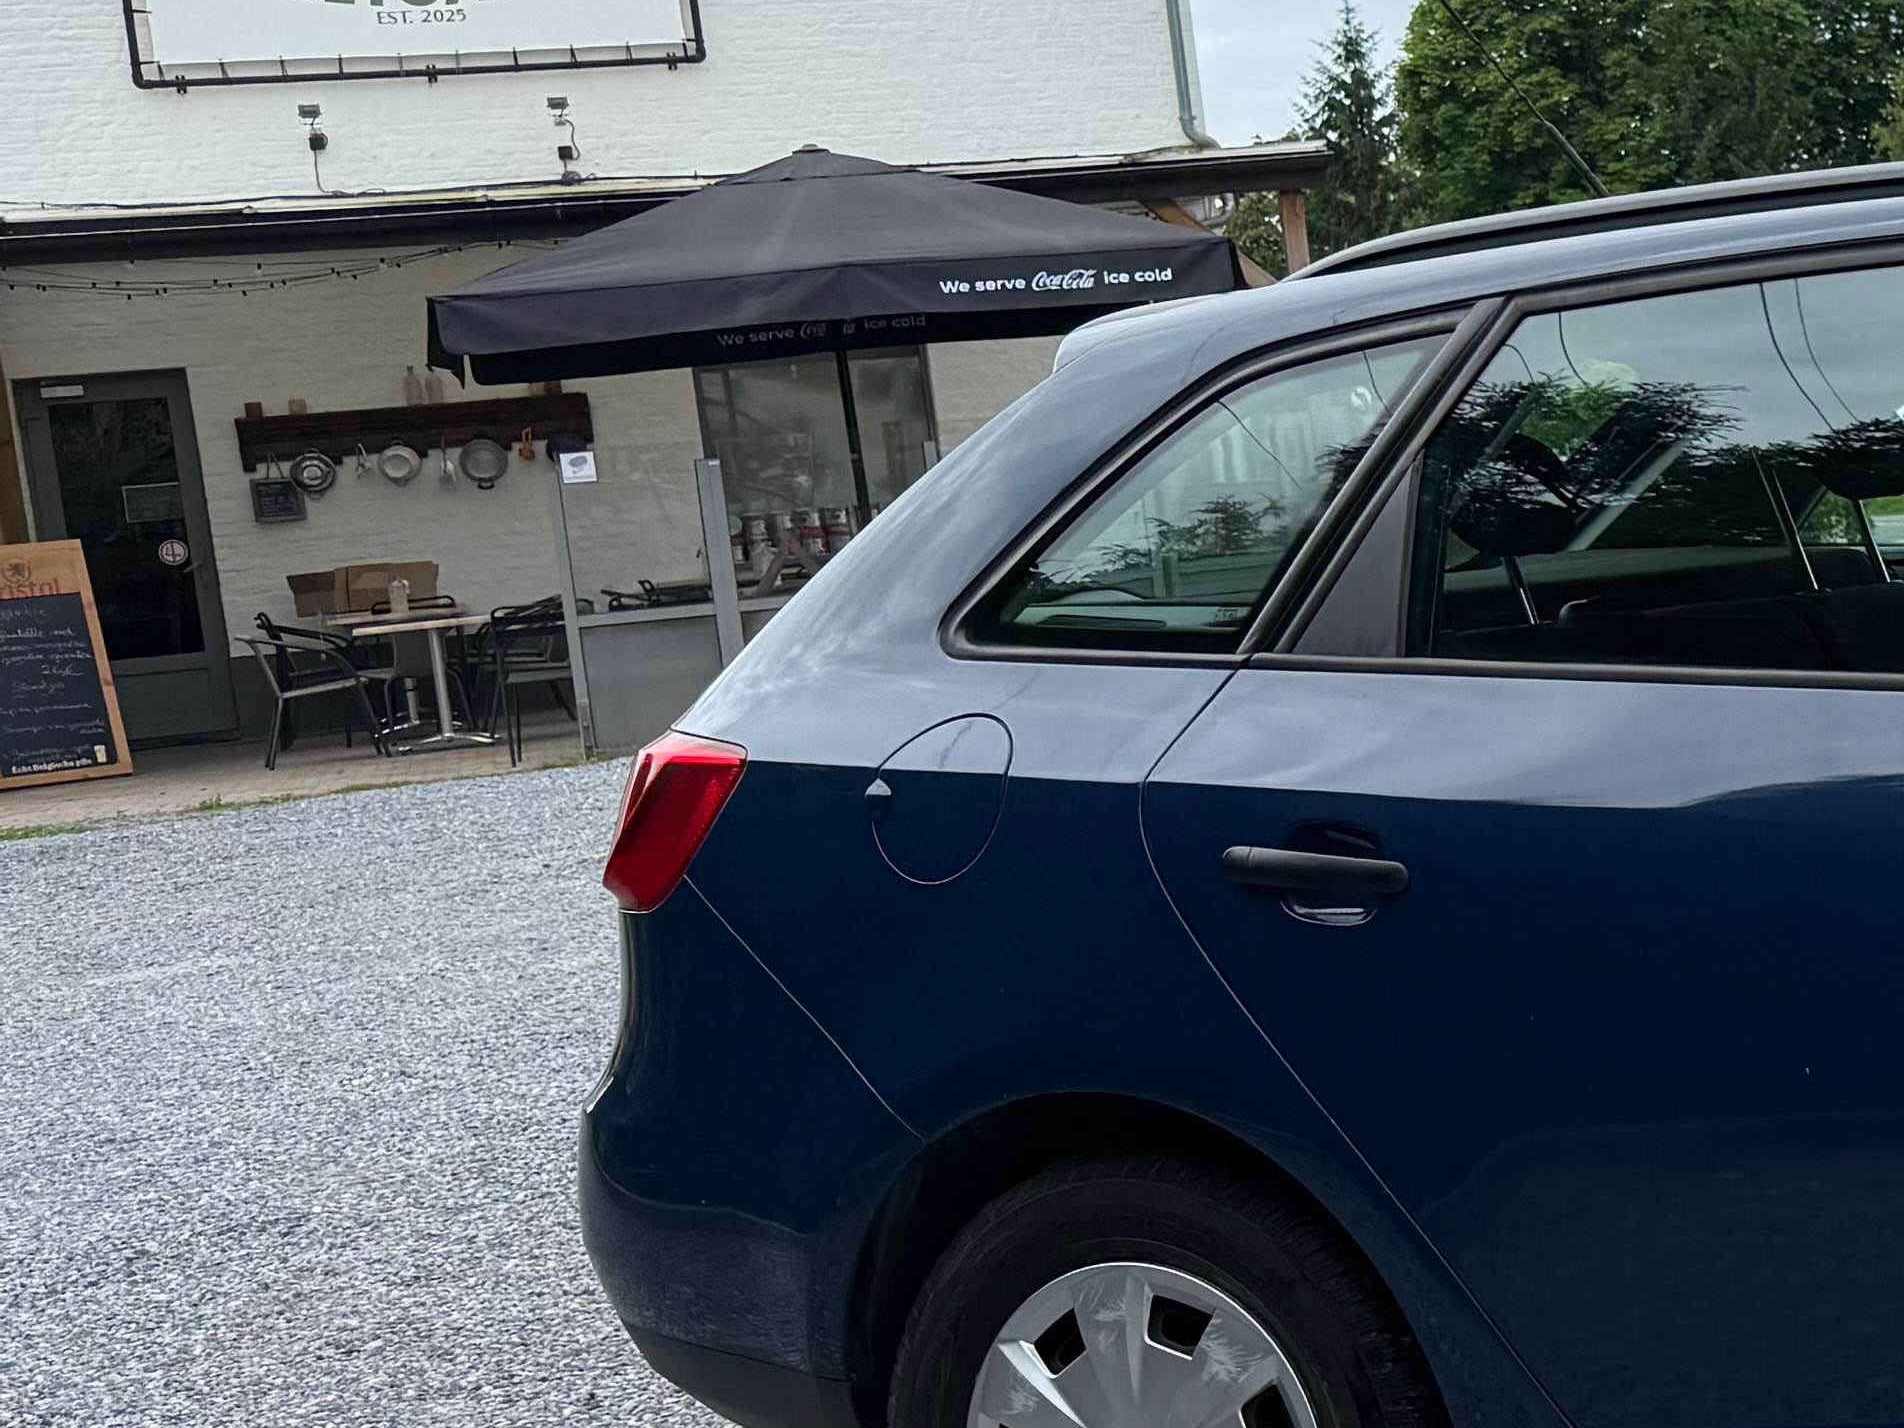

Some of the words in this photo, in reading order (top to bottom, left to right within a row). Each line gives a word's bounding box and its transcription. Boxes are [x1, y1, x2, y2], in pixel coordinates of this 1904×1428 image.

[376, 10, 413, 25] EST.
[421, 8, 467, 23] 2025
[939, 280, 971, 294] We
[974, 277, 1027, 292] serve
[1134, 267, 1173, 282] cold
[717, 332, 744, 346] We
[749, 328, 795, 342] serve
[892, 315, 927, 328] cold
